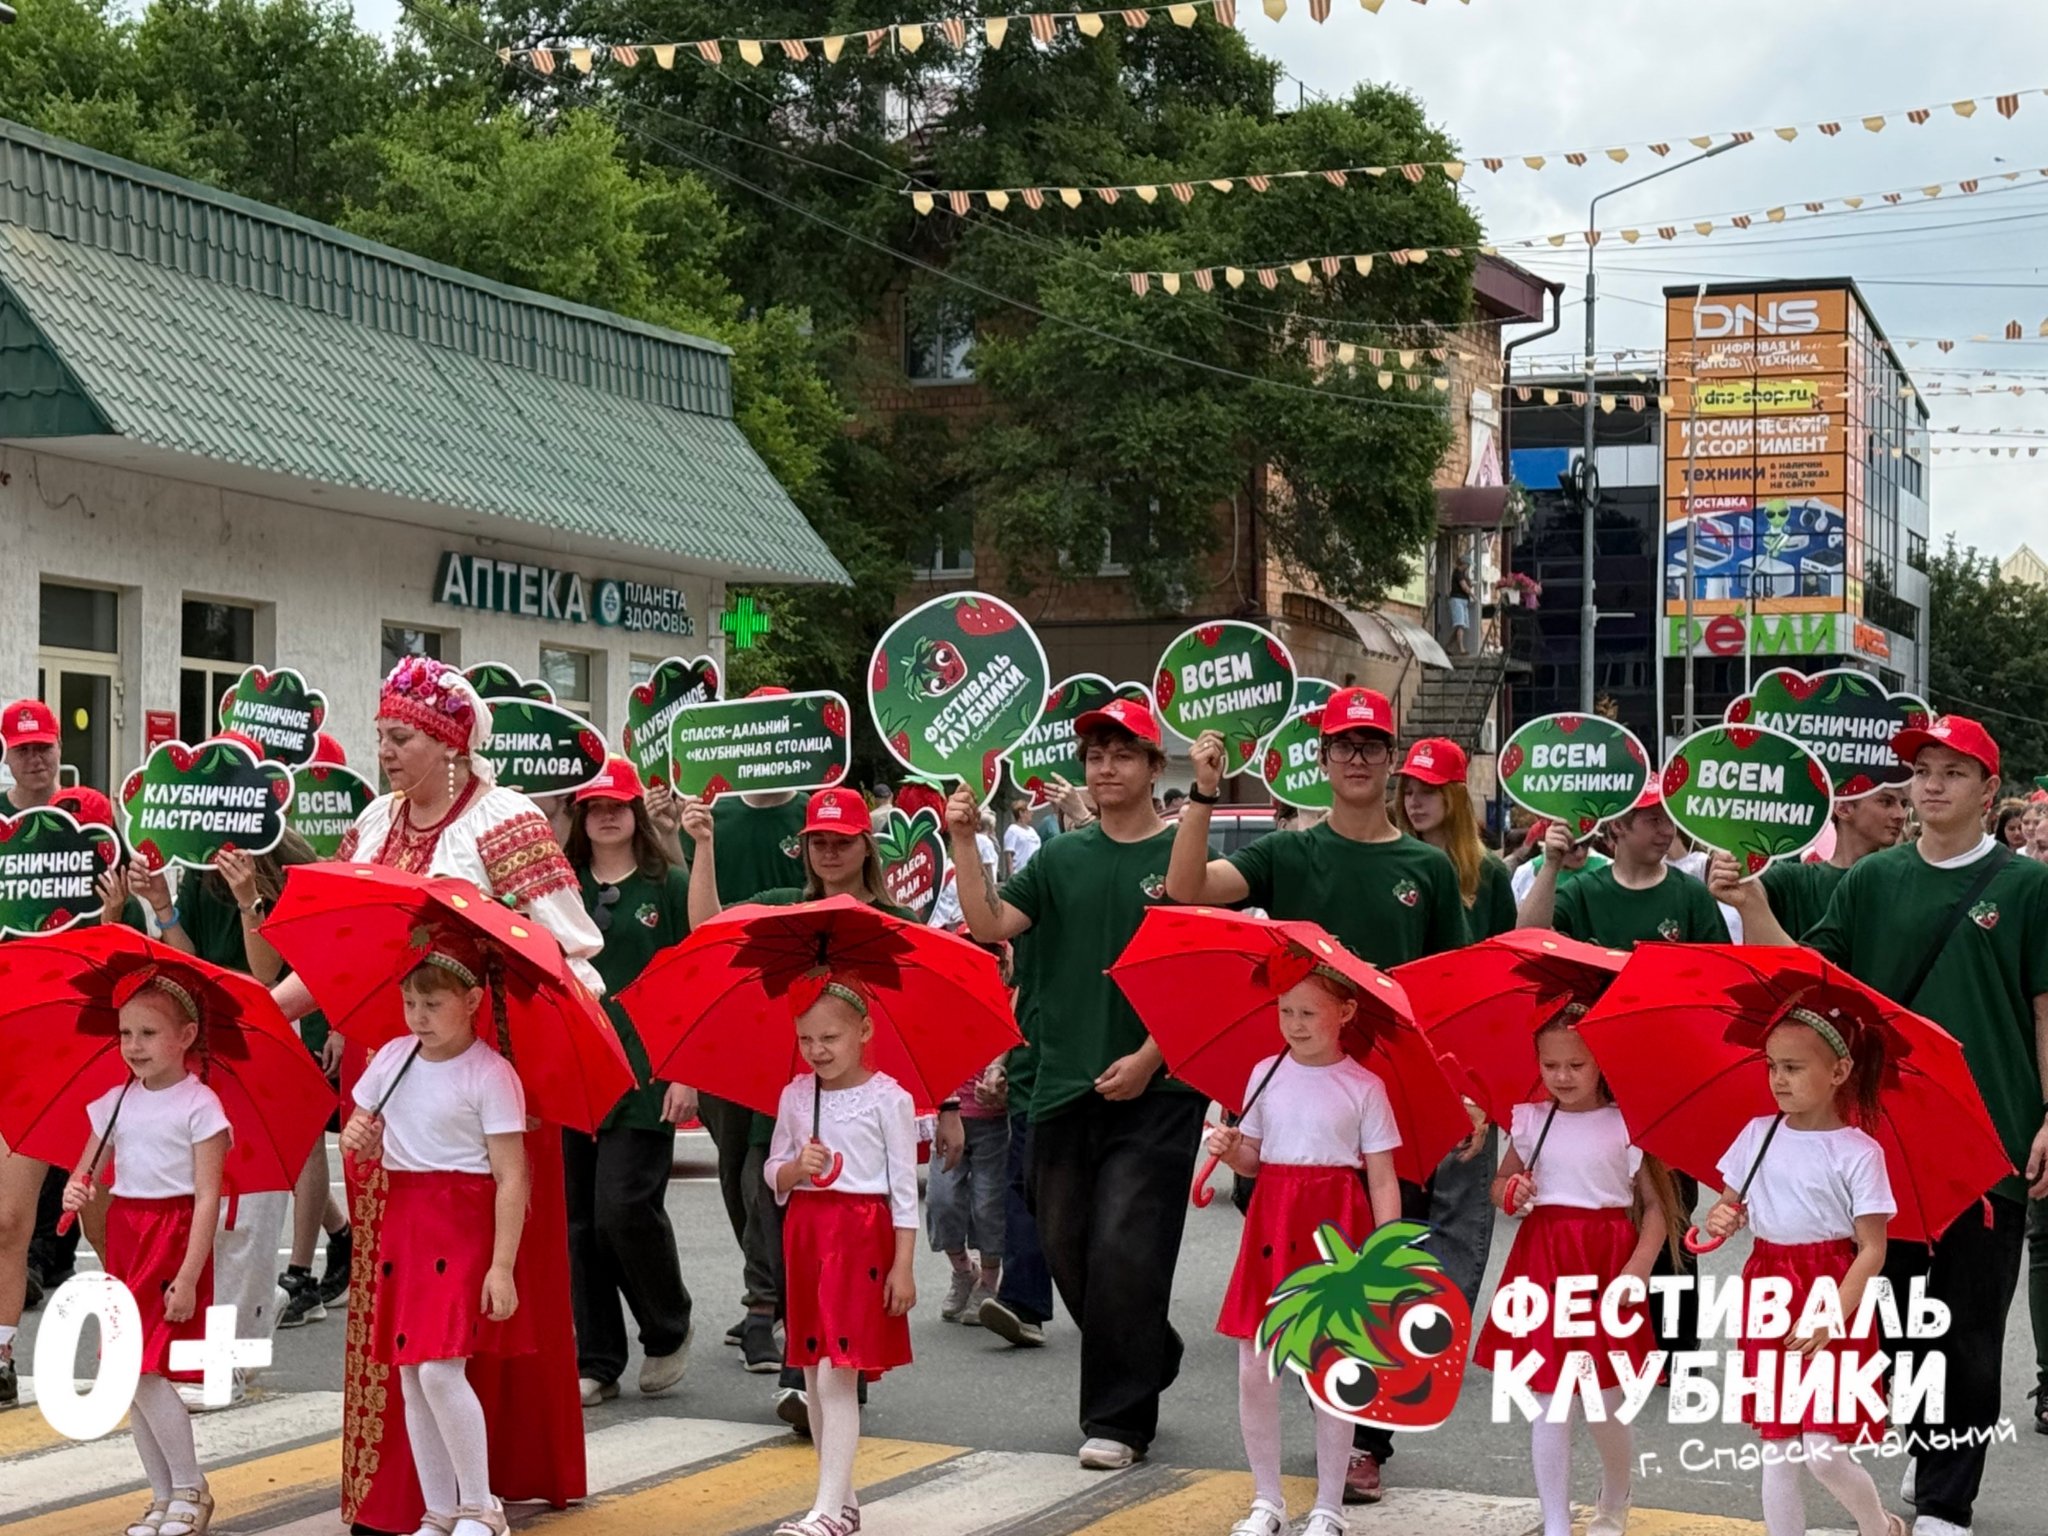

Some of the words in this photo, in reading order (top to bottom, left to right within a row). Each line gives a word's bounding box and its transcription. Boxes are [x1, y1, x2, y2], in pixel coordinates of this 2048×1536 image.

[1694, 299, 1820, 338] DNS
[1757, 354, 1819, 366] ТЕХНИКА
[1704, 388, 1808, 406] dns-shop.ru
[1681, 466, 1766, 482] техники
[440, 552, 589, 623] АПТЕКА
[624, 581, 688, 612] ПЛАНЕТА
[624, 606, 695, 636] ЗДОРОВЬЯ
[1181, 651, 1254, 694] ВСЕМ
[924, 654, 1012, 743] ФЕСТИВАЛЬ
[934, 664, 1026, 760] КЛУБНИКИ
[1178, 681, 1283, 724] КЛУБНИКИ!
[233, 699, 312, 730] КЛУБНИЧНОЕ
[229, 720, 306, 752] НАСТРОЕНИЕ
[481, 733, 553, 751] УБНИКА
[680, 717, 791, 743] СПАССК-ДАЛЬНИЙ
[686, 740, 773, 762] «КЛУБНИЧНАЯ
[774, 735, 833, 757] СТОЛИЦА
[1531, 743, 1607, 769] ВСЕМ
[512, 757, 584, 776] ГОЛОВА
[737, 759, 812, 780] ПРИМОРЬЯ»
[1698, 759, 1785, 795] ВСЕМ
[143, 783, 269, 809] КЛУБНИЧНОЕ
[1522, 773, 1635, 793] КЛУБНИКИ!
[298, 791, 353, 814] ВСЕМ
[1686, 795, 1815, 827] КЛУБНИКИ!
[140, 809, 265, 834] НАСТРОЕНИЕ
